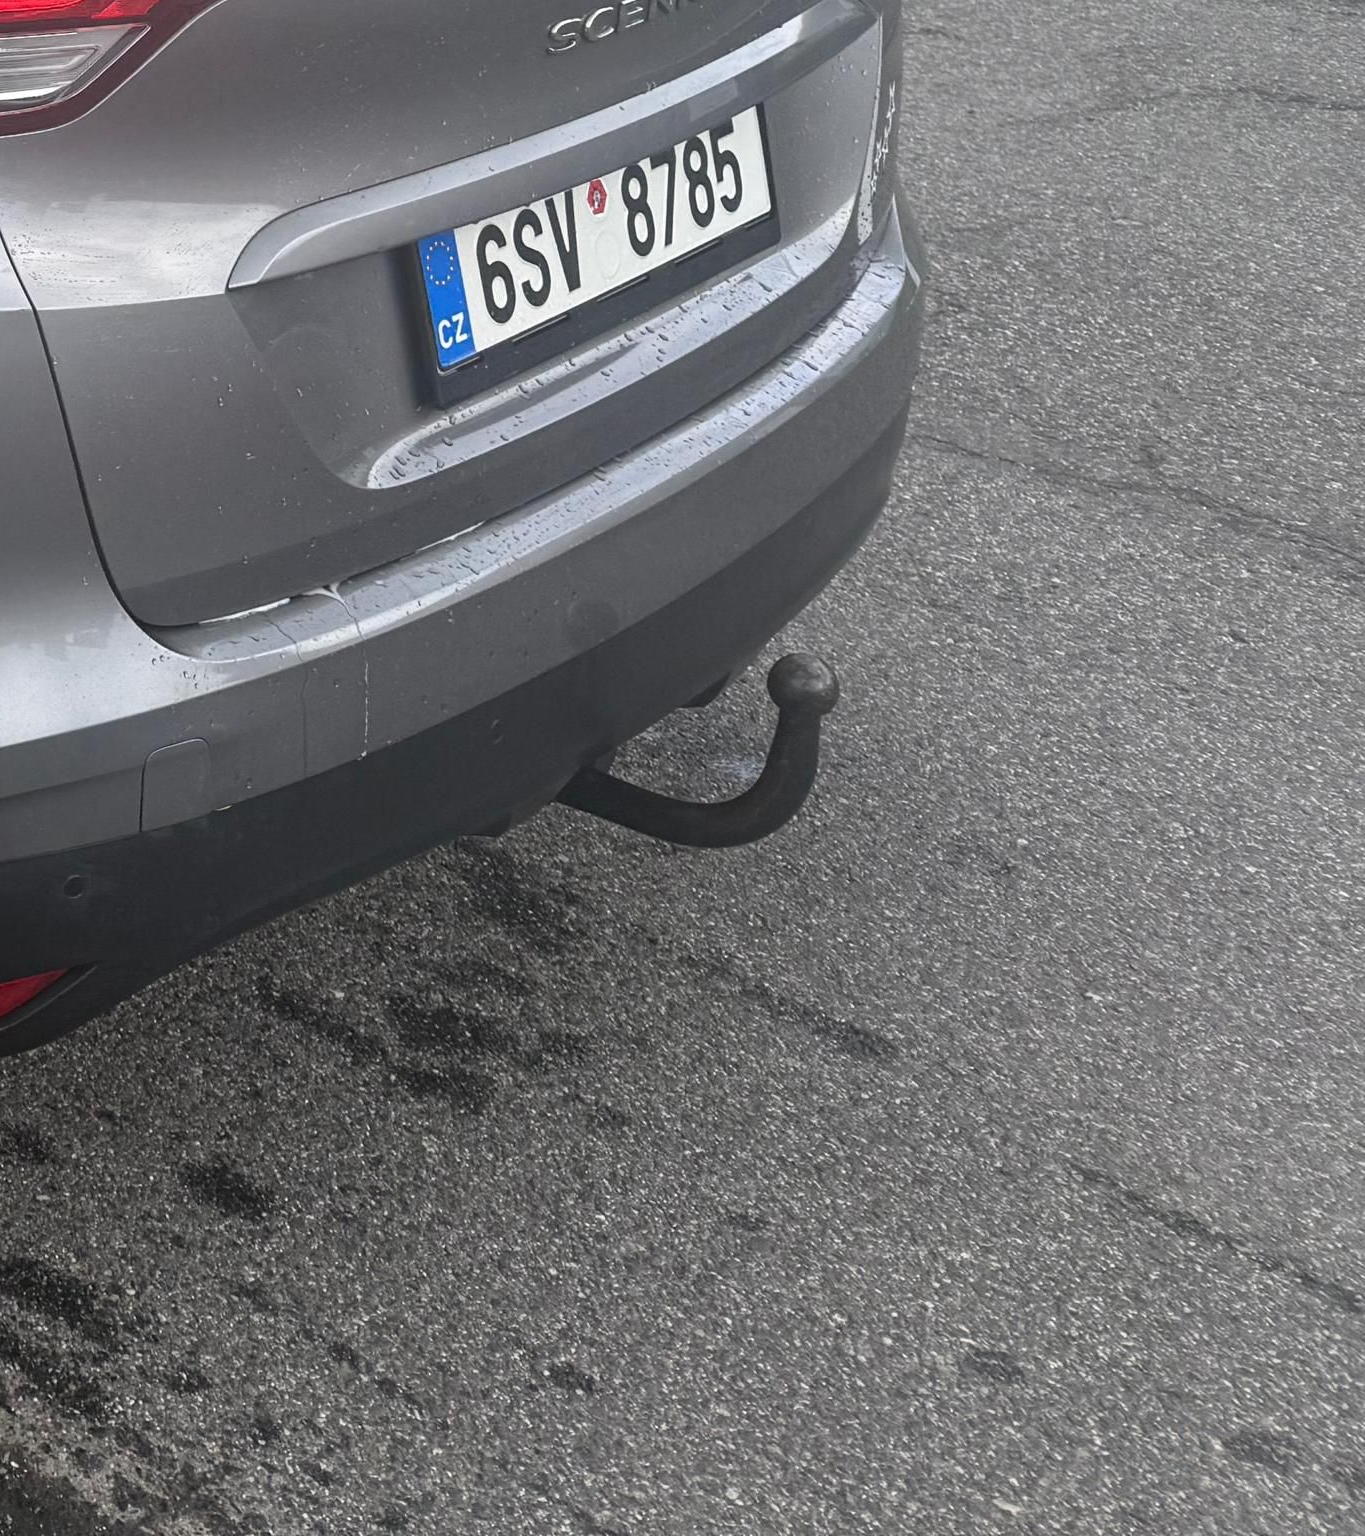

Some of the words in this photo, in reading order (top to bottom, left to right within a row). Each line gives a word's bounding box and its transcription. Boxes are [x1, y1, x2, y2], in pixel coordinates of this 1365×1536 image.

[476, 187, 581, 324] 6SV
[621, 118, 744, 258] 8785
[437, 311, 468, 350] CZ
